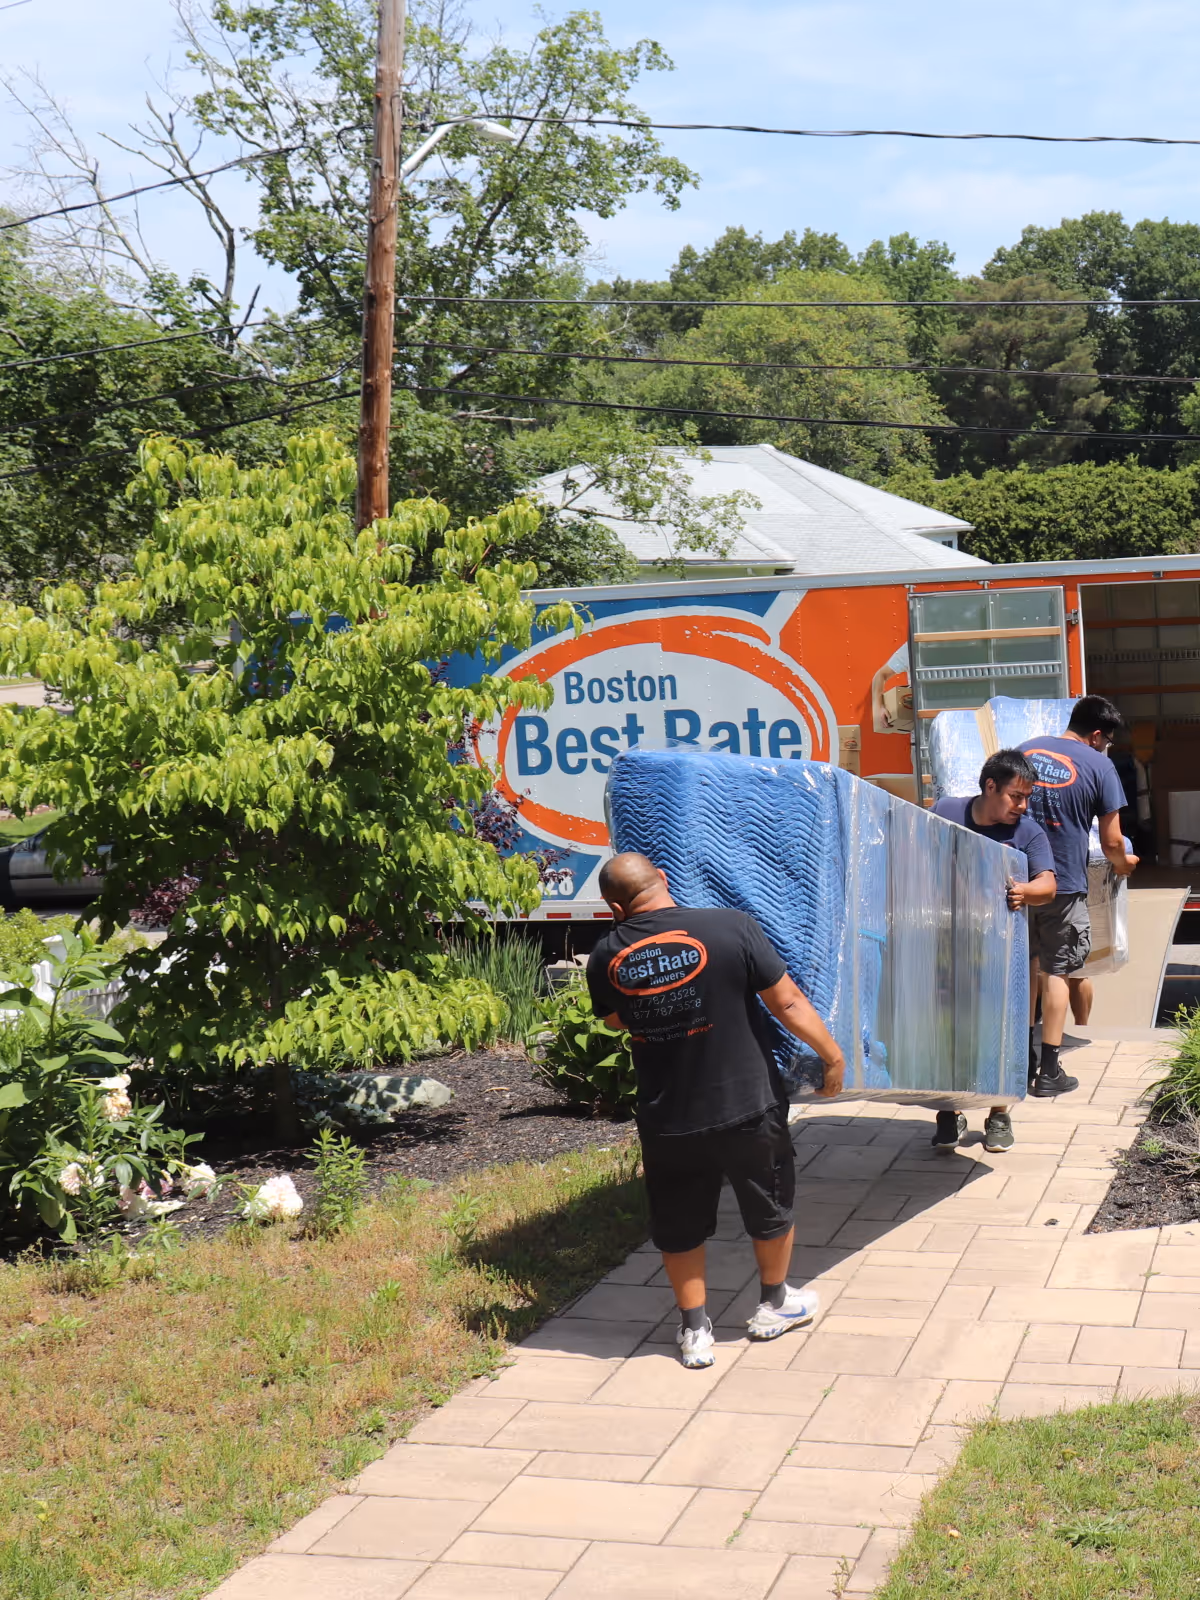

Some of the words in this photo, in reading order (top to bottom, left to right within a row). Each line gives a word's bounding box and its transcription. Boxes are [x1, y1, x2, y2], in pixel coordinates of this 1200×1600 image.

[564, 670, 677, 704] Boston
[514, 713, 645, 777] Best
[664, 707, 802, 760] Rate
[1032, 753, 1052, 764] Boston
[1044, 764, 1071, 780] Rate
[618, 959, 655, 982] Best
[657, 949, 700, 973] Rate
[628, 947, 662, 963] Boston
